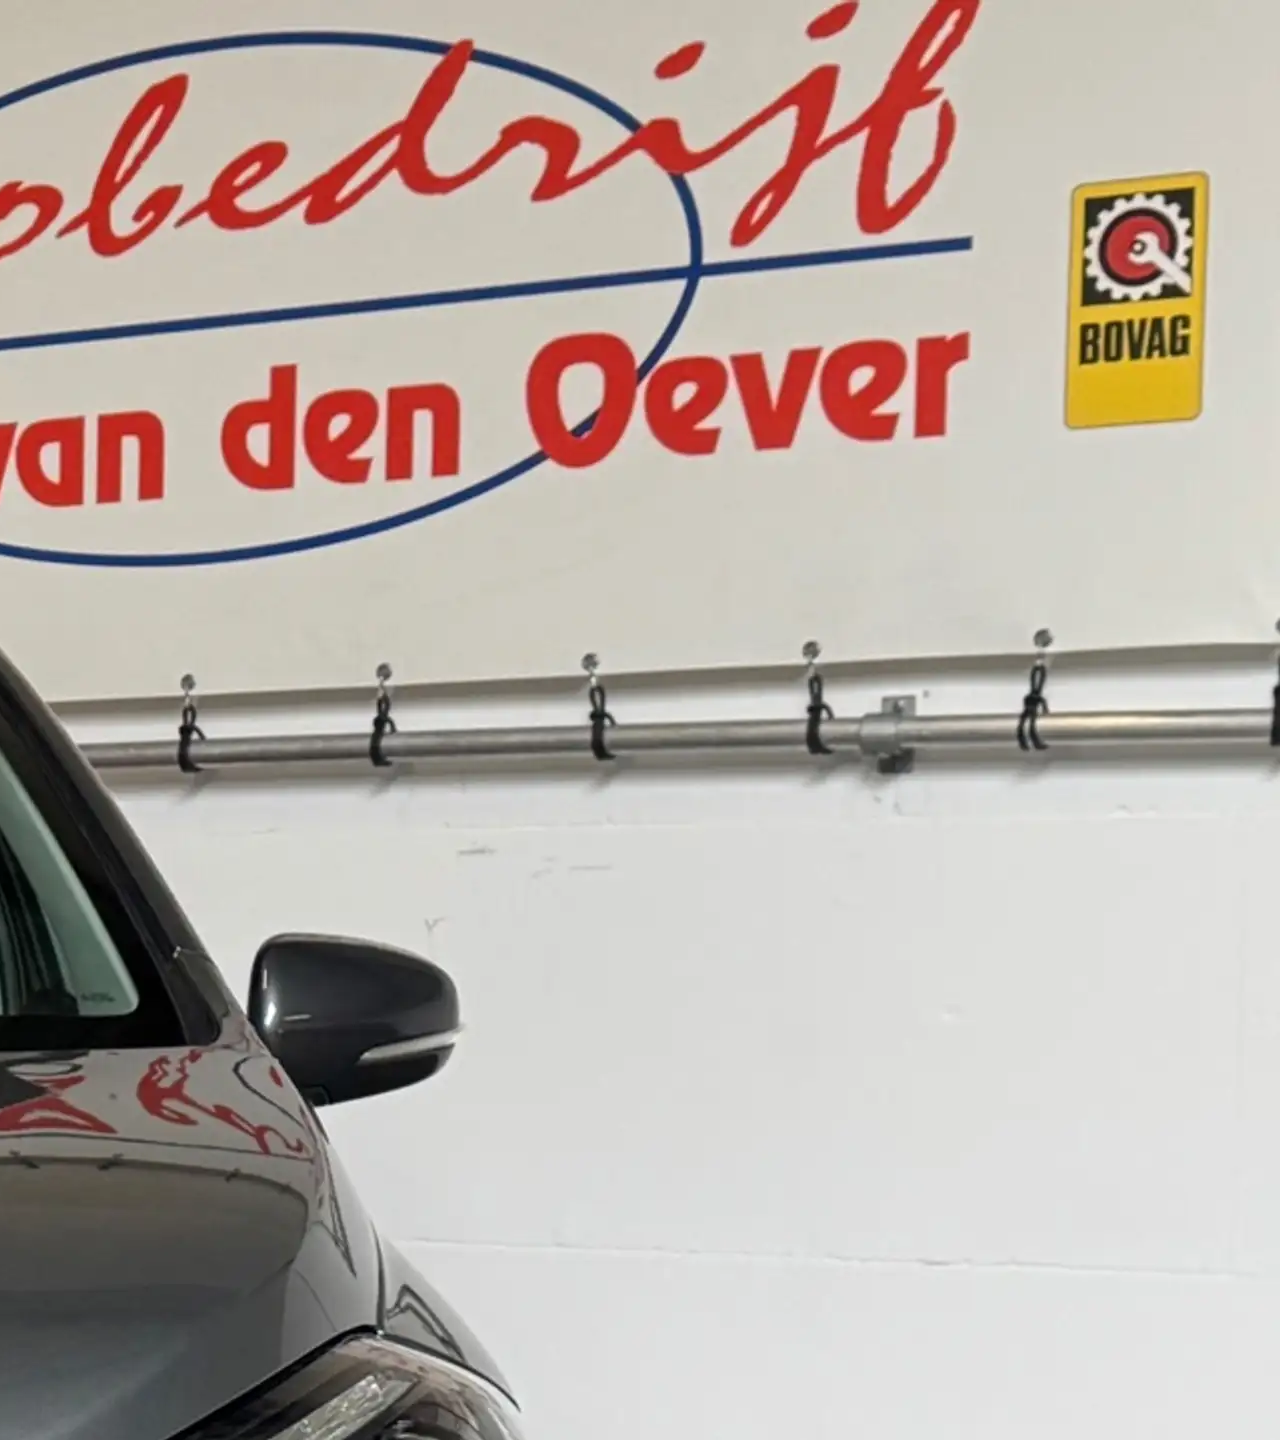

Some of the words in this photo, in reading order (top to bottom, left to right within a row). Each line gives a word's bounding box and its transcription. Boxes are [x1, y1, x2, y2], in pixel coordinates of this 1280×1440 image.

[1079, 314, 1190, 365] BOVAG
[220, 364, 461, 491] den
[525, 332, 971, 469] Oever
